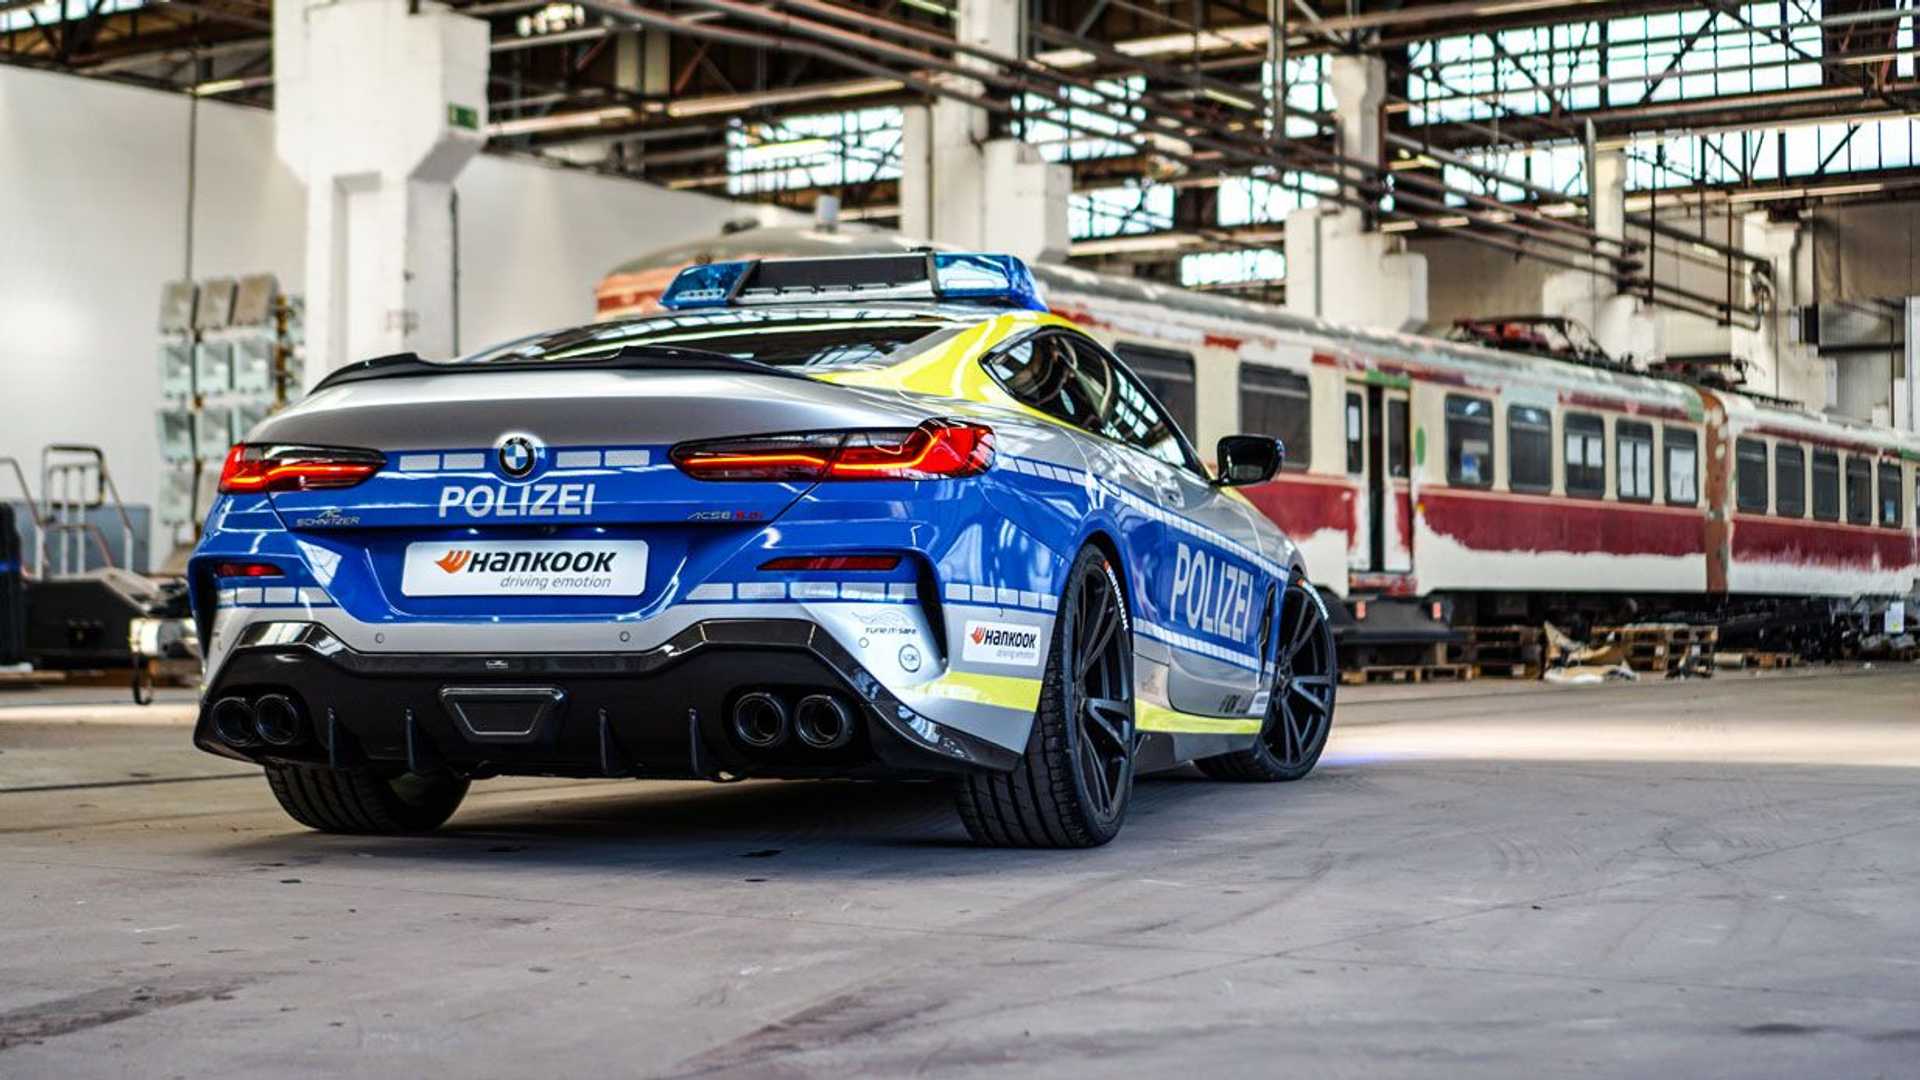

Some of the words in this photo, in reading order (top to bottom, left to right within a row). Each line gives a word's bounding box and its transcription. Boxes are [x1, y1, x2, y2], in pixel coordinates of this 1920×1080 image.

[438, 483, 595, 518] POLIZEI
[296, 516, 361, 527] SCHNITZER
[467, 551, 617, 573] HANKOOK
[500, 575, 549, 590] driving
[552, 576, 612, 588] emotion
[1170, 543, 1255, 644] POLIZEI
